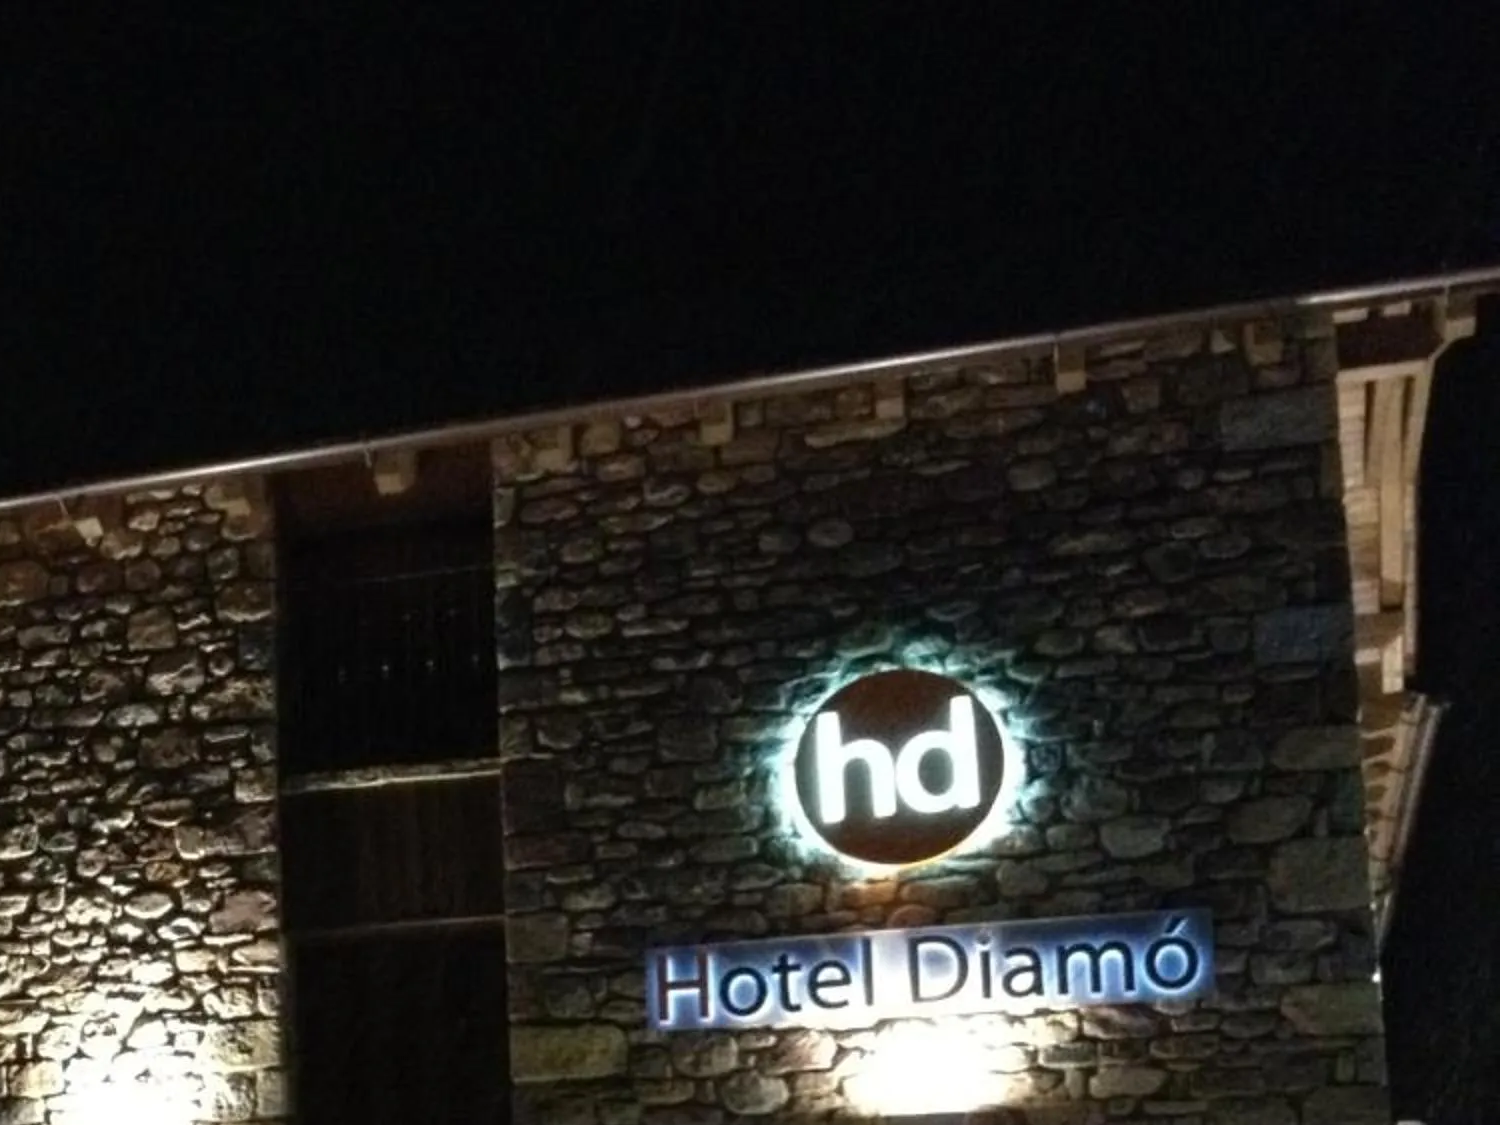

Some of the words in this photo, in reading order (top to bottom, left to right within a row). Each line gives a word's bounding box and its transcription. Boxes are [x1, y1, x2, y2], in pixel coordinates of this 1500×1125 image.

[815, 695, 981, 824] hd
[657, 937, 874, 1022] Hotel
[908, 916, 1200, 1003] Diamó
